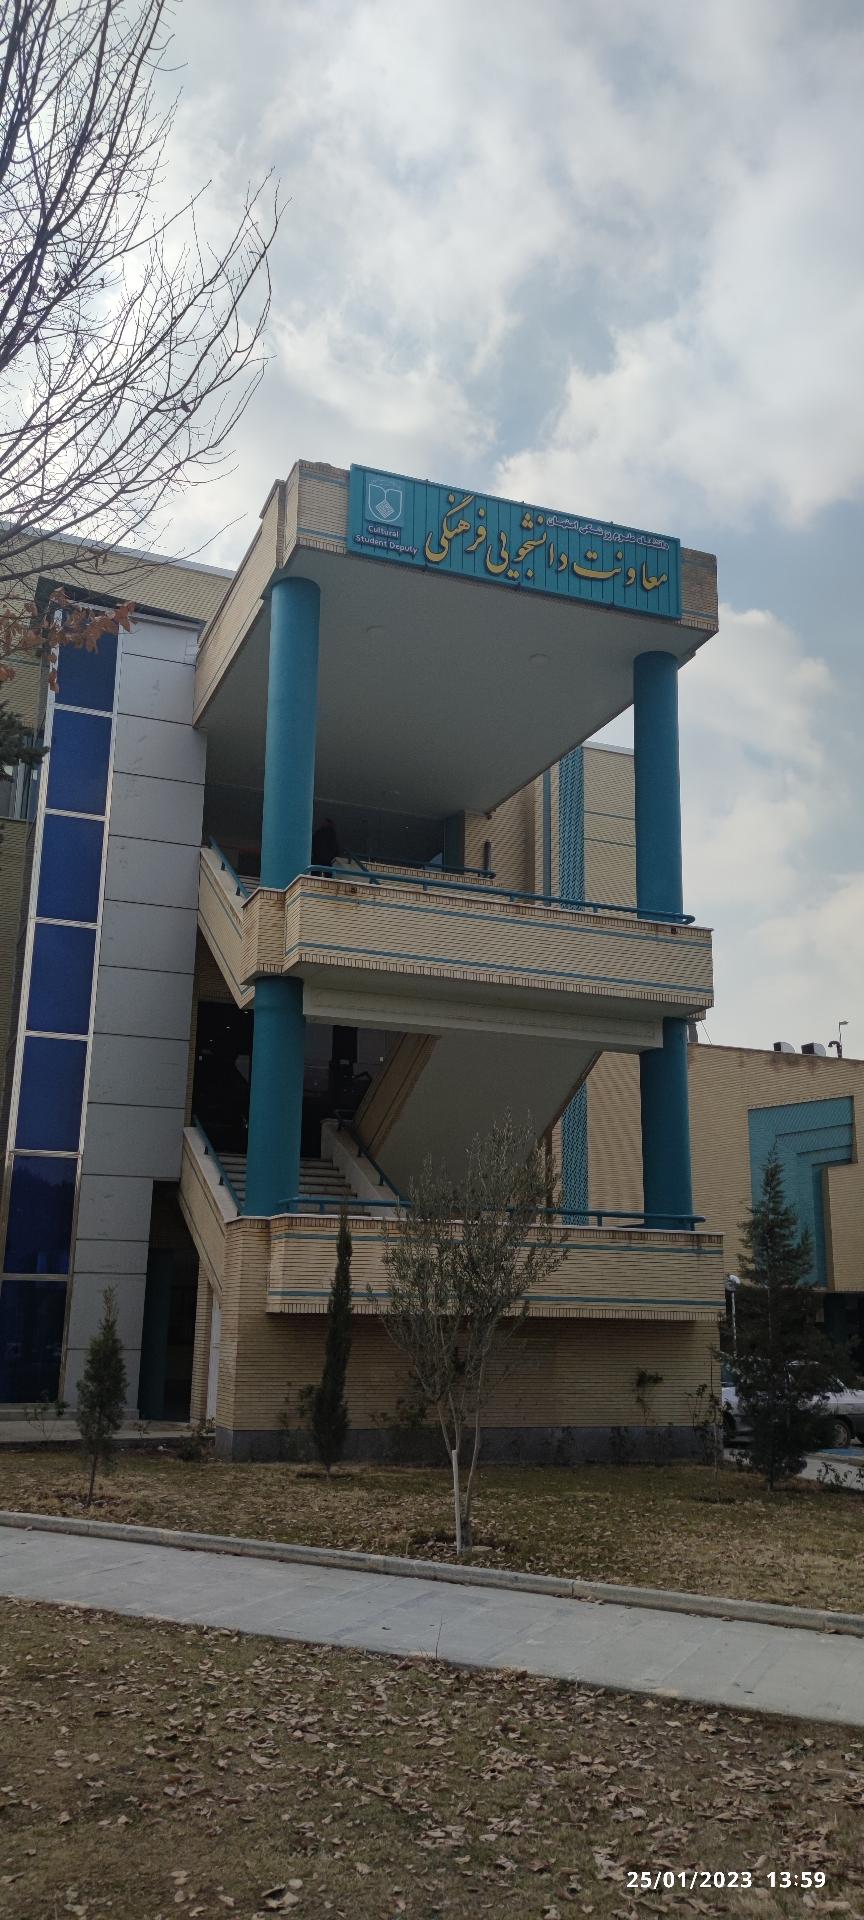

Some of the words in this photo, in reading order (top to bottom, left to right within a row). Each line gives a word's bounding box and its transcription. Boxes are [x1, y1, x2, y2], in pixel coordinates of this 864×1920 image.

[368, 525, 400, 538] Cultural
[424, 494, 487, 563] فرهنگی
[546, 515, 579, 530] اصفهان
[578, 524, 612, 542] پزشکی
[612, 532, 636, 544] علوم
[355, 534, 388, 548] Student
[389, 541, 418, 556] Deputy
[486, 512, 569, 580] دانشجویی
[636, 535, 669, 551] دانشگاه
[572, 548, 669, 592] معاونت
